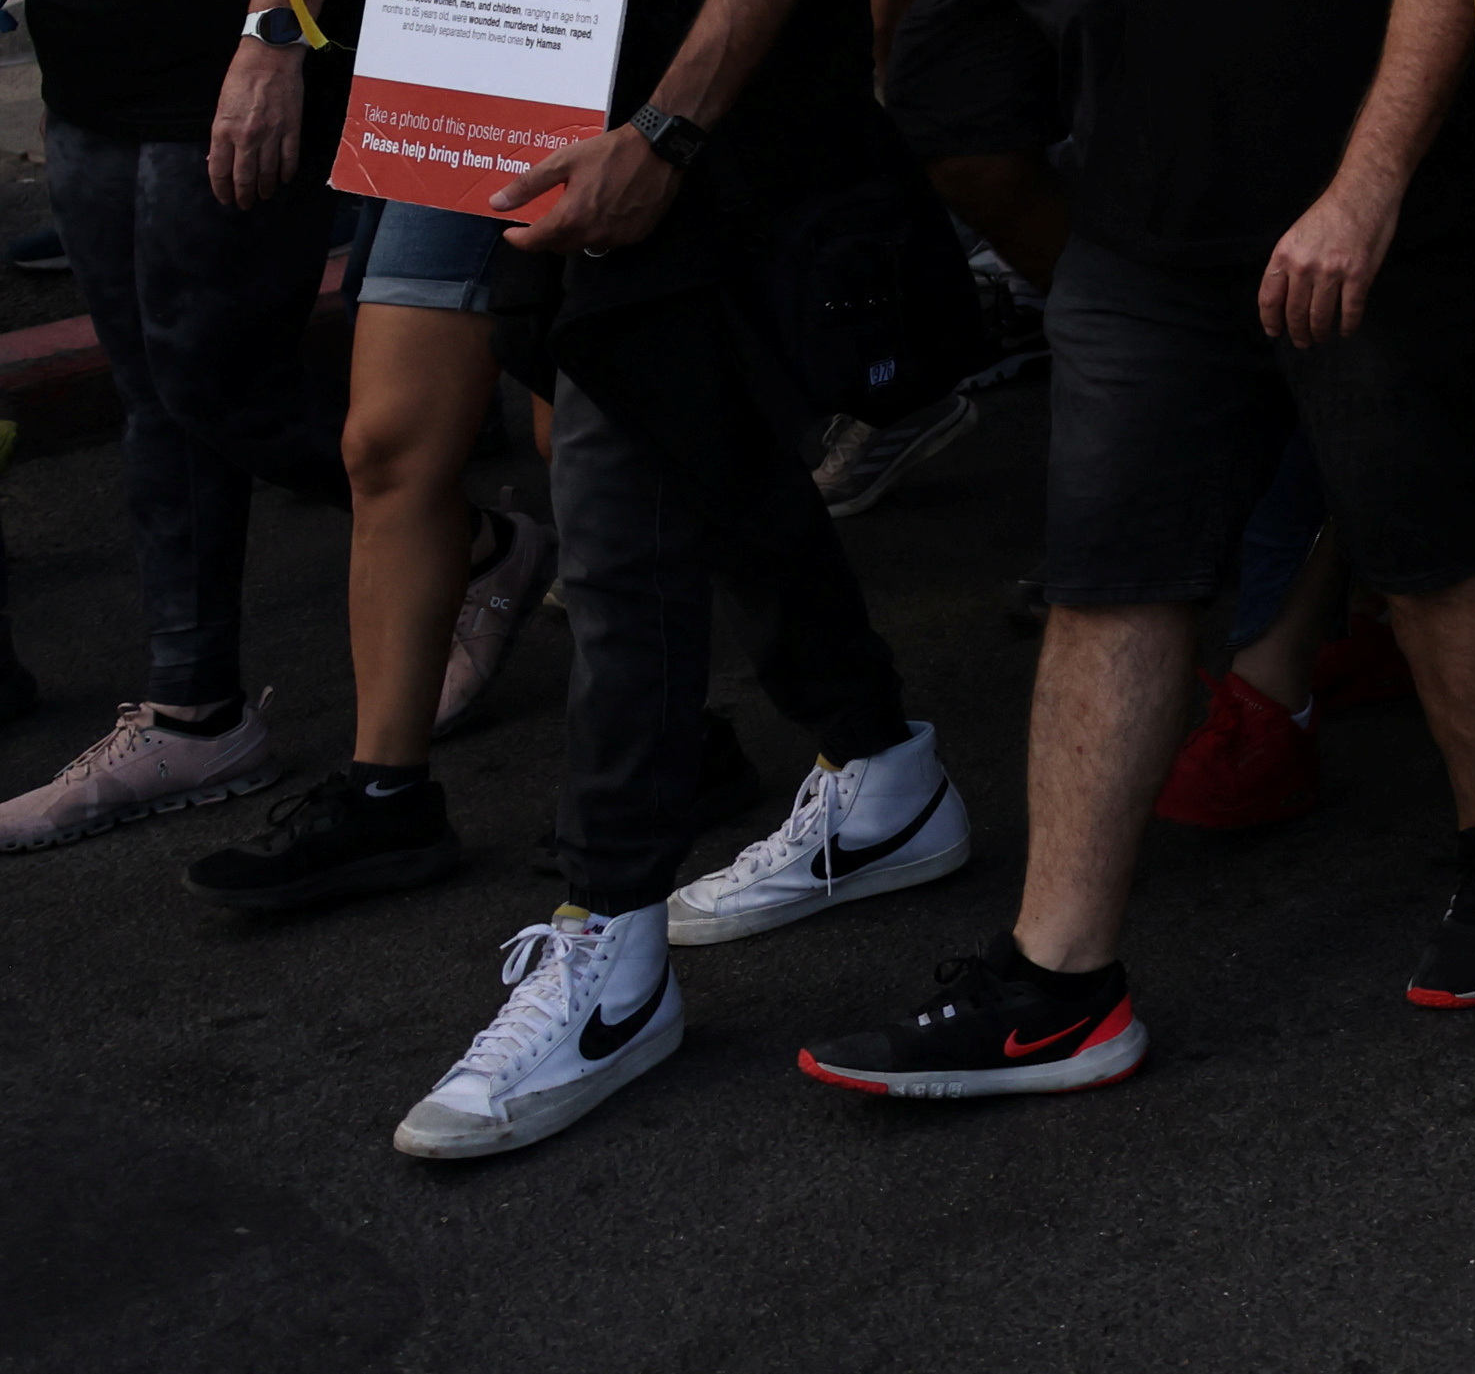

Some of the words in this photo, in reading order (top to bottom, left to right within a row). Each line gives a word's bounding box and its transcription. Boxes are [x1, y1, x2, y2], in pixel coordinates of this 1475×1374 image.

[362, 131, 399, 155] Please
[402, 139, 427, 161] help
[429, 142, 459, 168] bring
[462, 149, 493, 170] them
